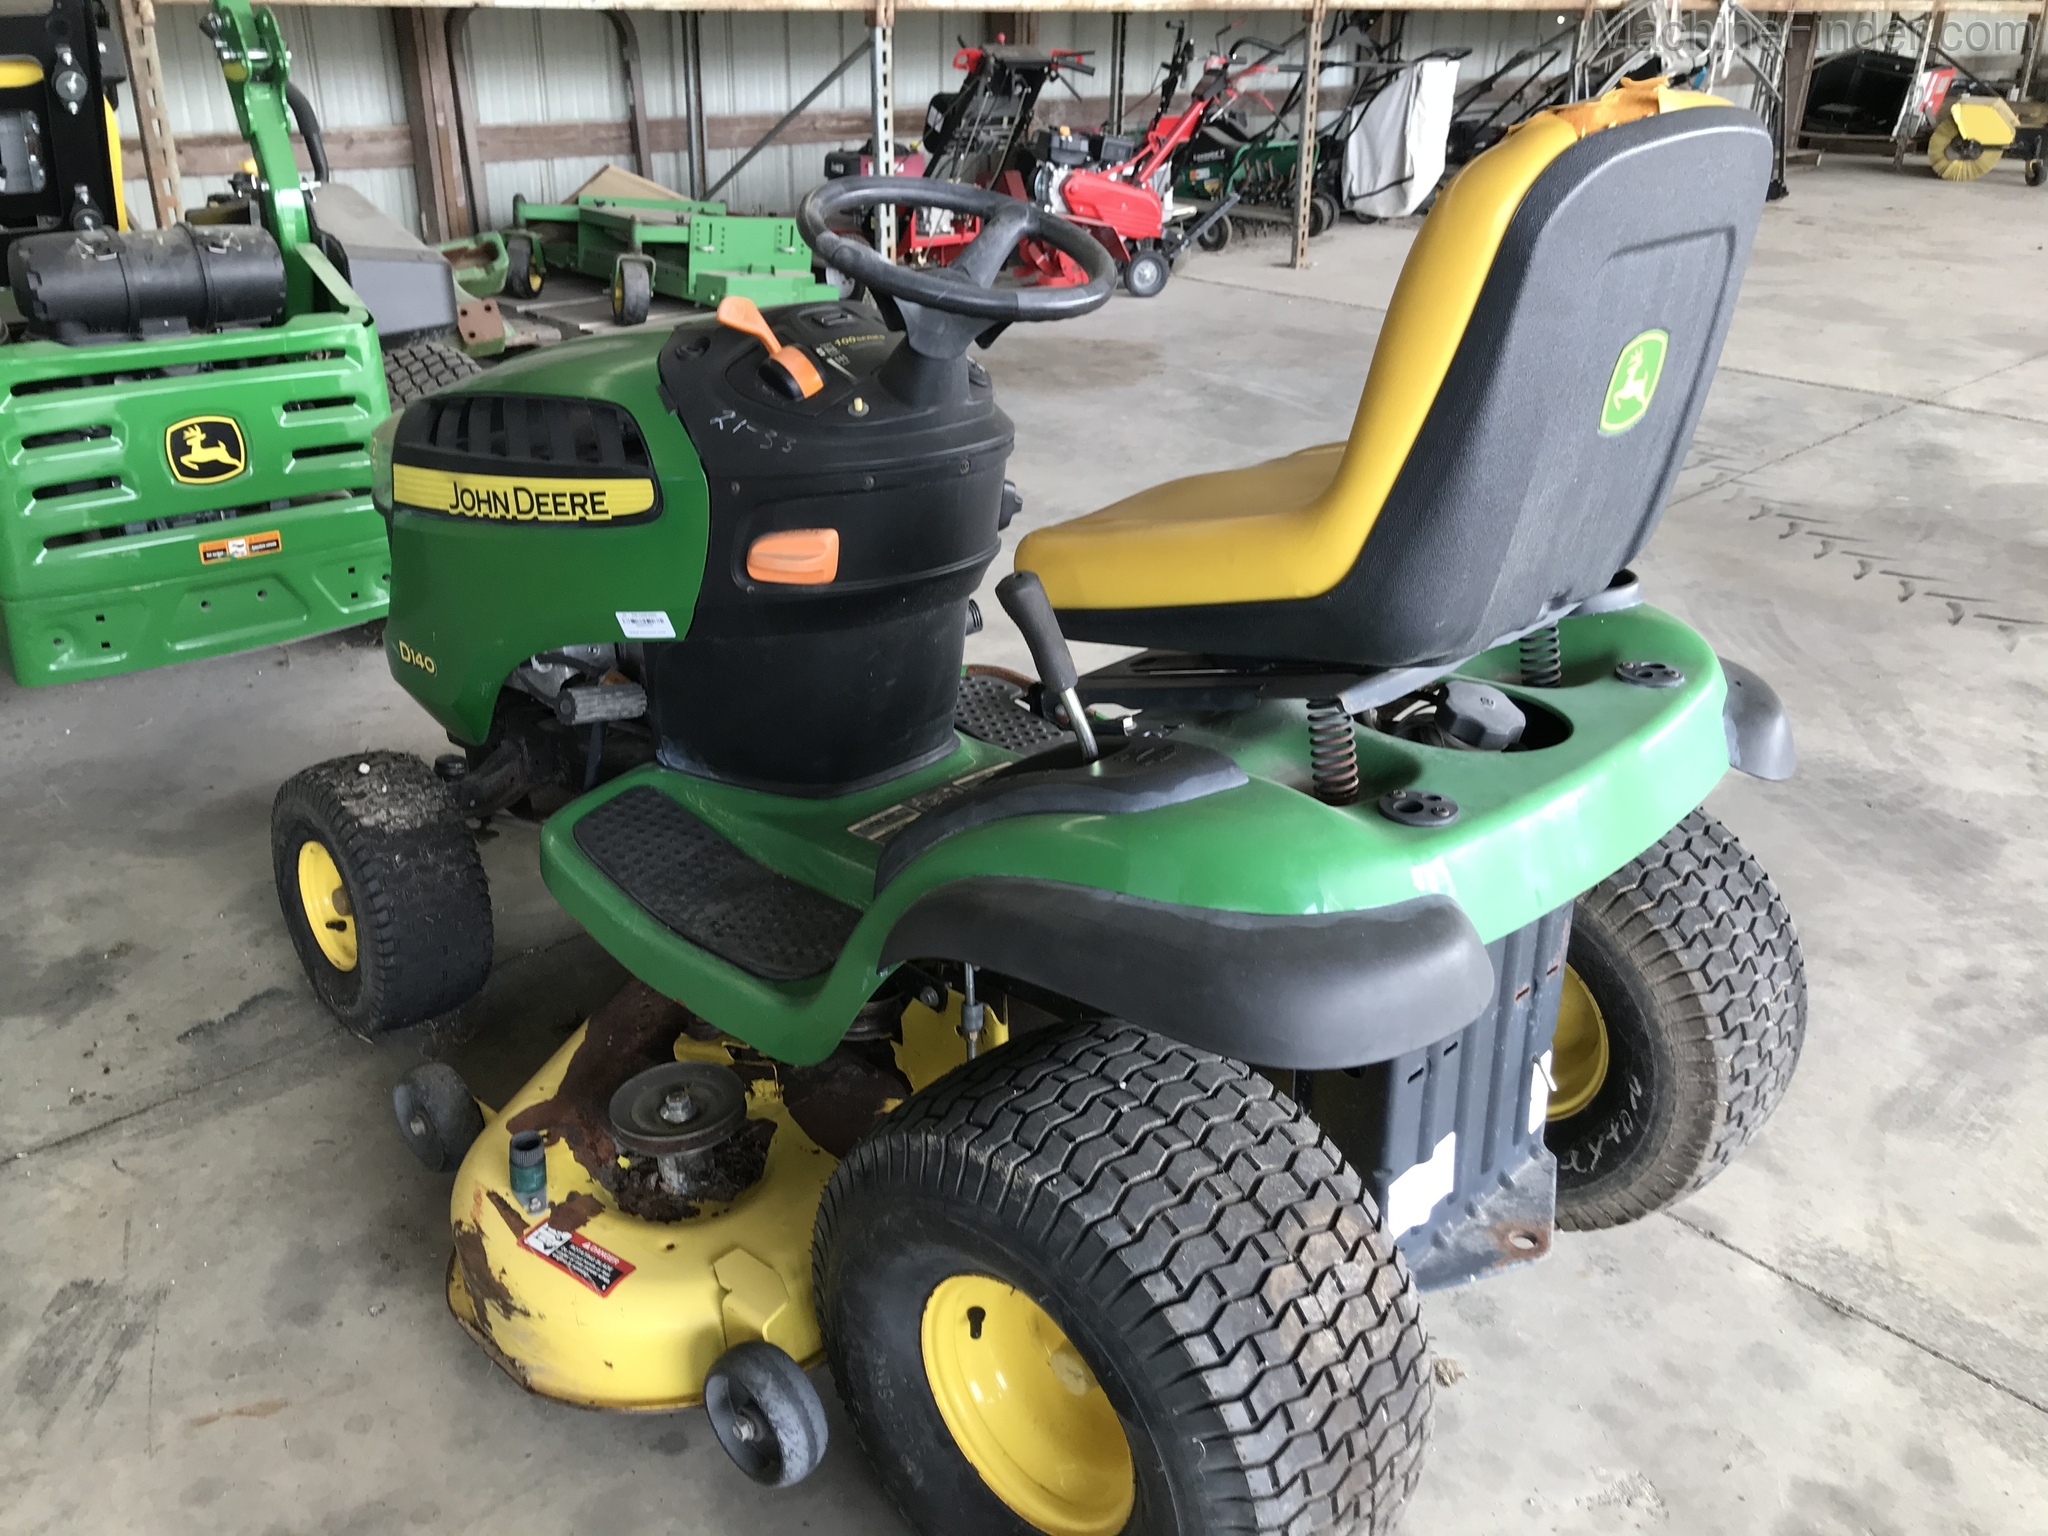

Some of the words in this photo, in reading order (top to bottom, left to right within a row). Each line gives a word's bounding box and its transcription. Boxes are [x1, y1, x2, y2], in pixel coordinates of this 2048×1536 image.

[449, 481, 510, 515] JOHN
[512, 486, 610, 518] DEERE
[398, 639, 435, 674] D140
